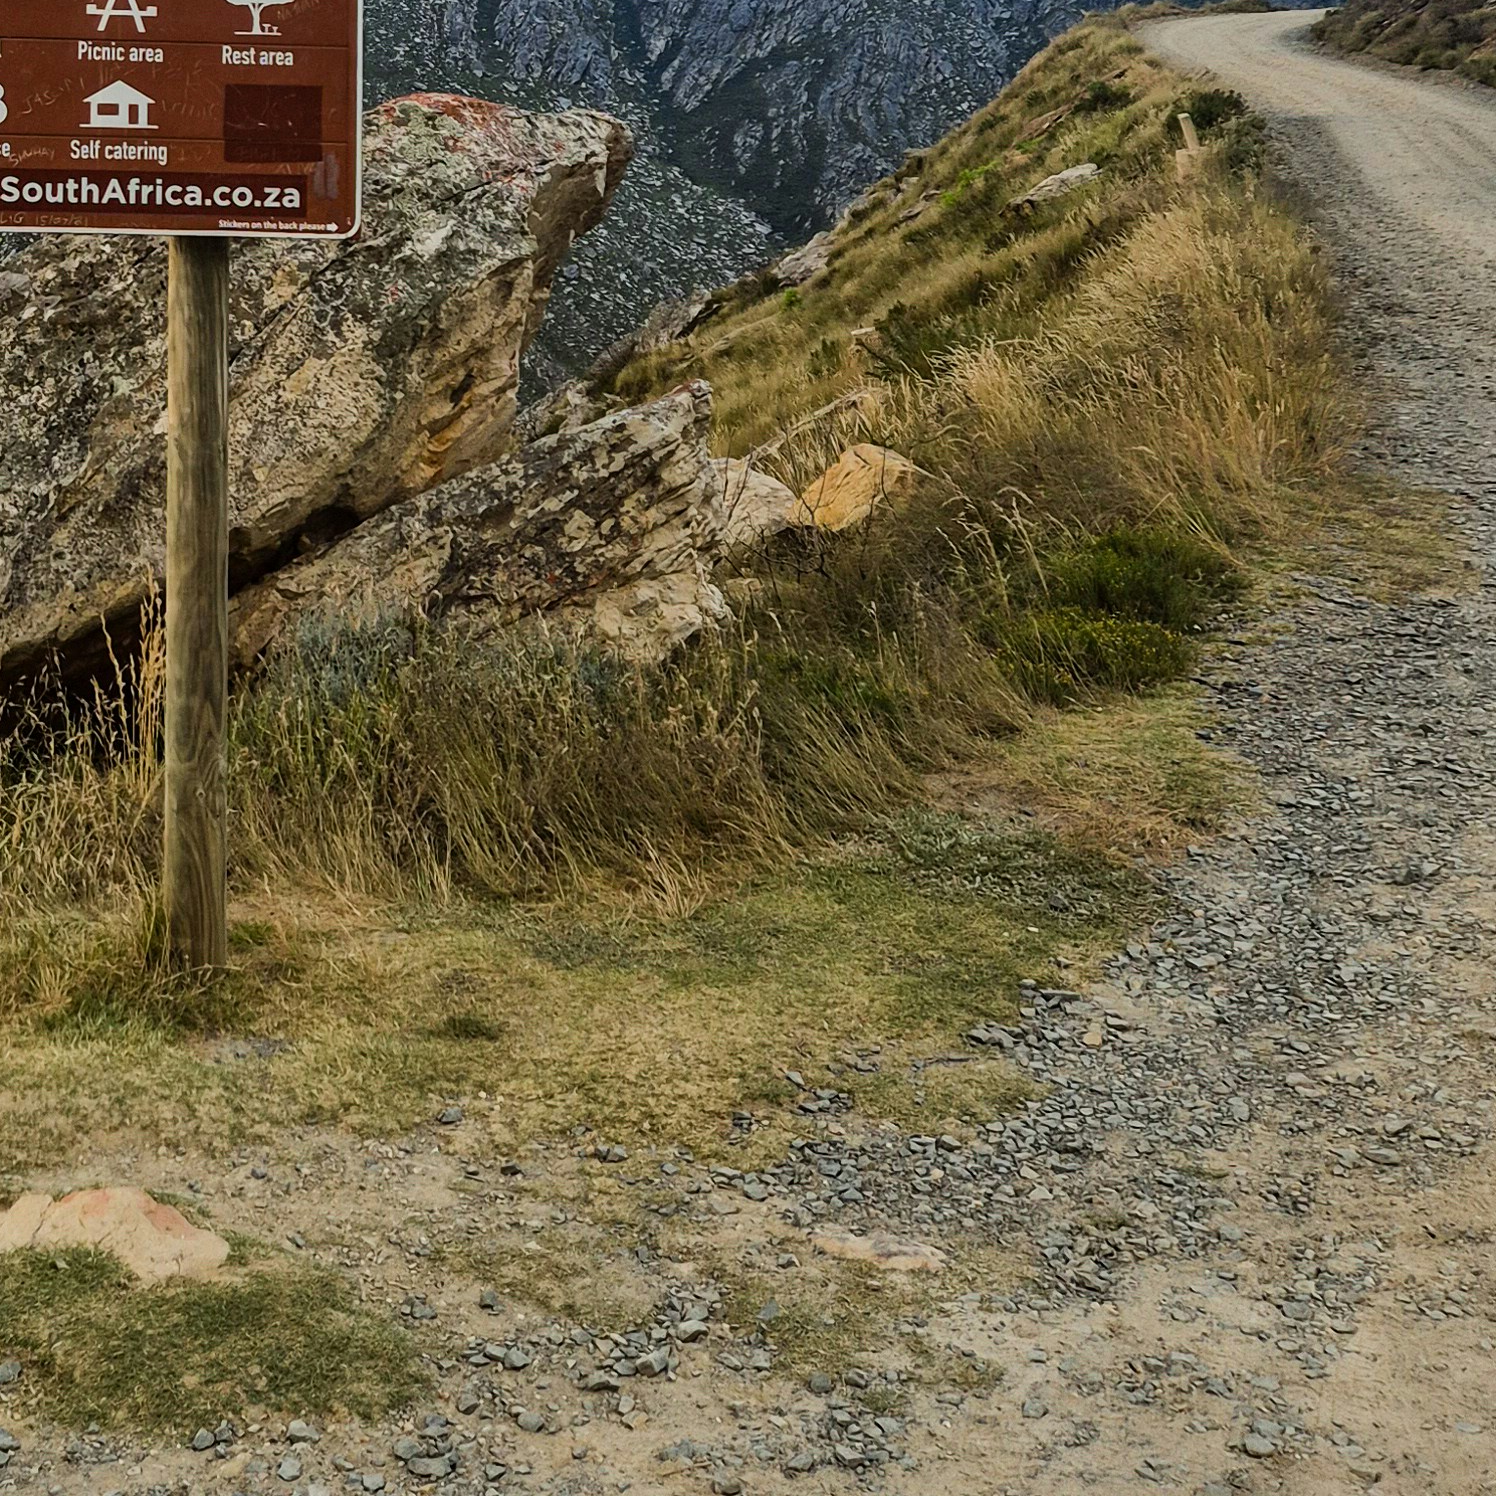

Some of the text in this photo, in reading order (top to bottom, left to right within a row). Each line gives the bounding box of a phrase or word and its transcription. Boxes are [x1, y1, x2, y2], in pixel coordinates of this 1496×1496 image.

[77, 40, 164, 63] Picnic area
[222, 44, 294, 66] Rest area
[71, 140, 167, 165] Self catering
[251, 221, 262, 229] on
[264, 220, 277, 230] the
[278, 220, 298, 230] back
[299, 221, 325, 232] please
